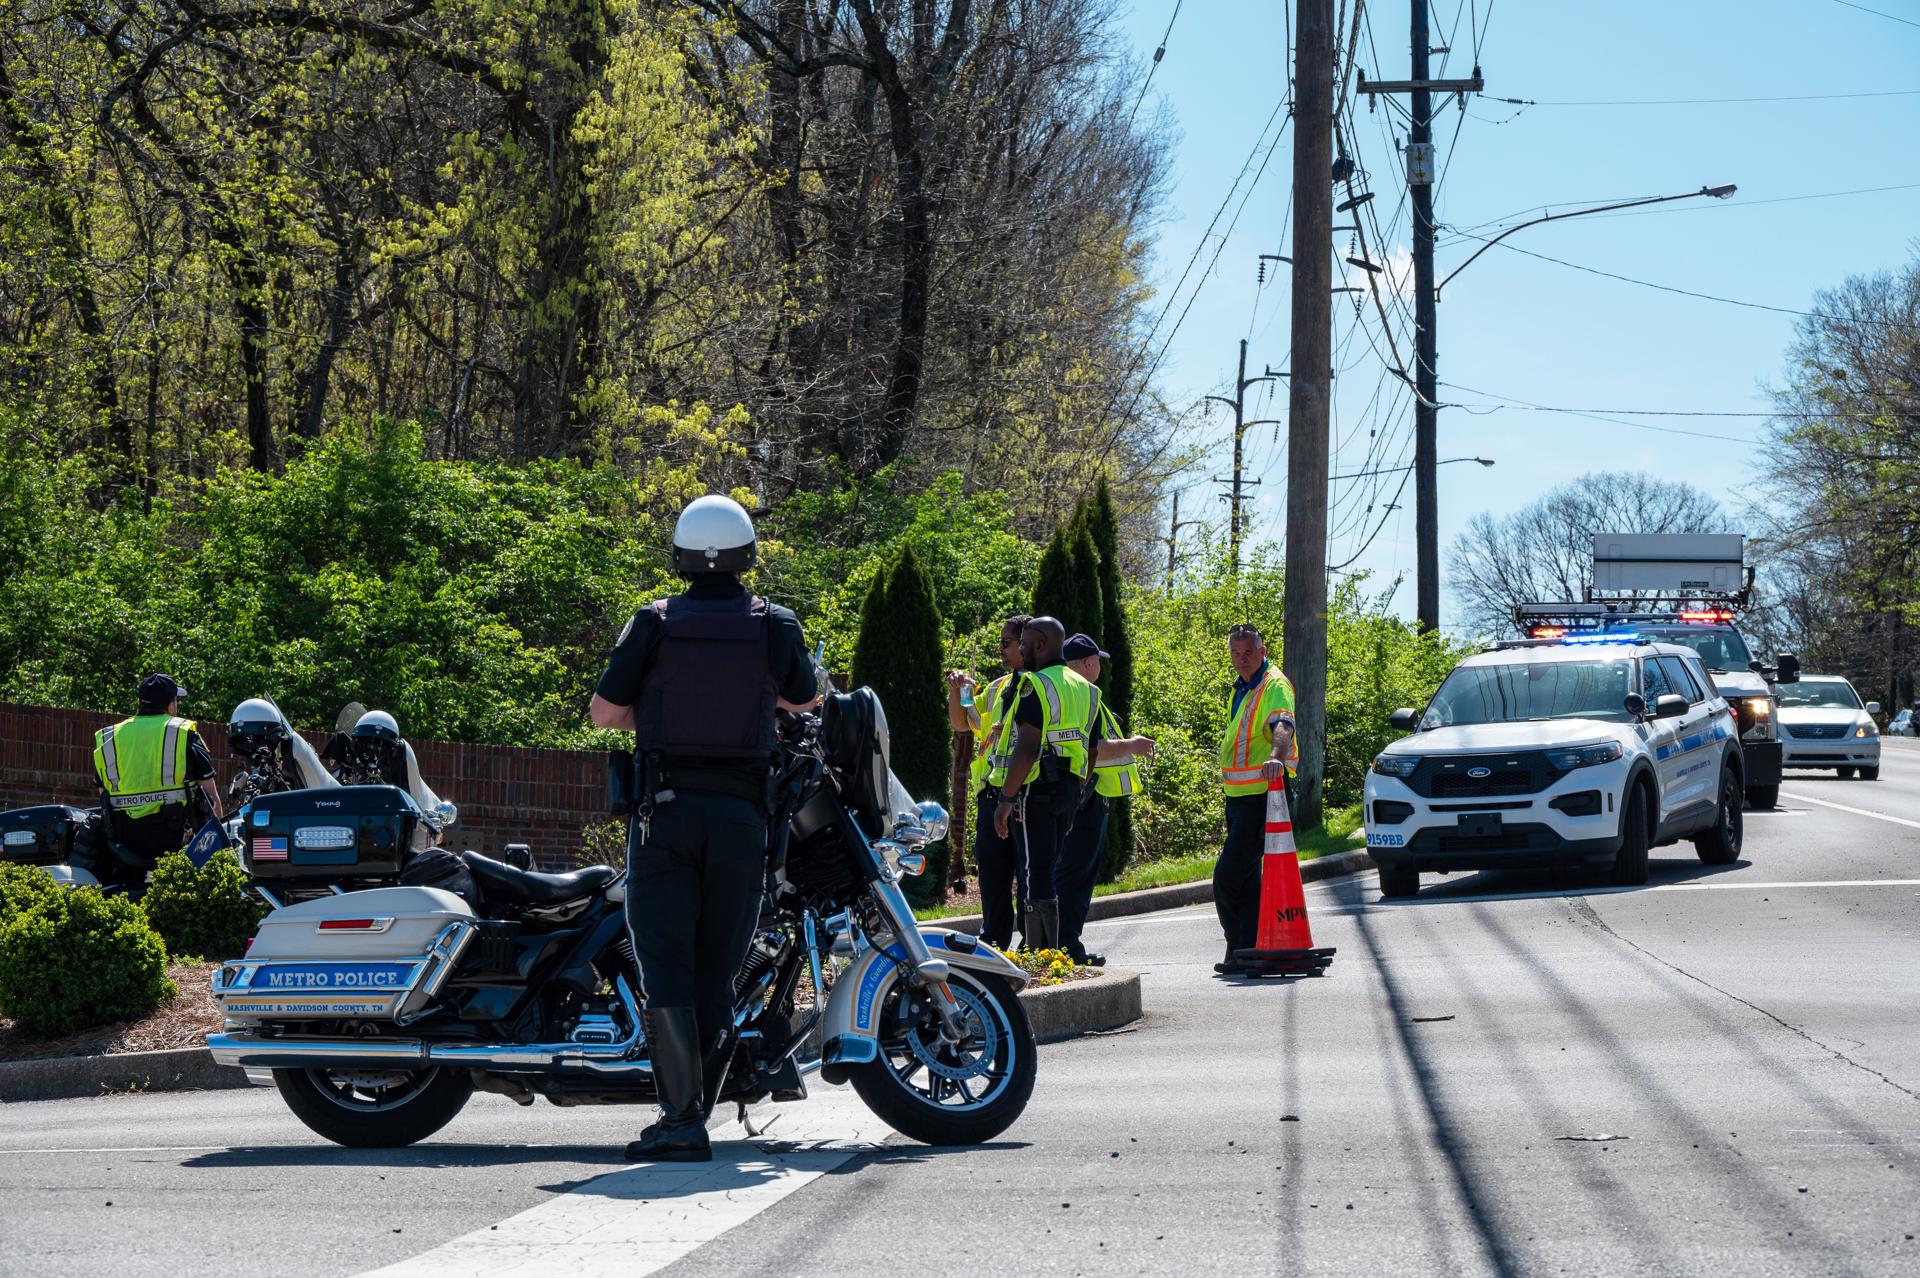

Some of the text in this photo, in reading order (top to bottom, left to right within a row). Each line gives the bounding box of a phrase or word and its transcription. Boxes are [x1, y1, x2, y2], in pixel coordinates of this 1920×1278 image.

[1058, 729, 1081, 739] METR
[116, 793, 168, 806] ETRO POLICE
[1367, 833, 1404, 846] 9159BB
[269, 972, 397, 986] METRO POLICE
[227, 1004, 384, 1012] NASHVILLE & DAVIDSON COUNTY, TN
